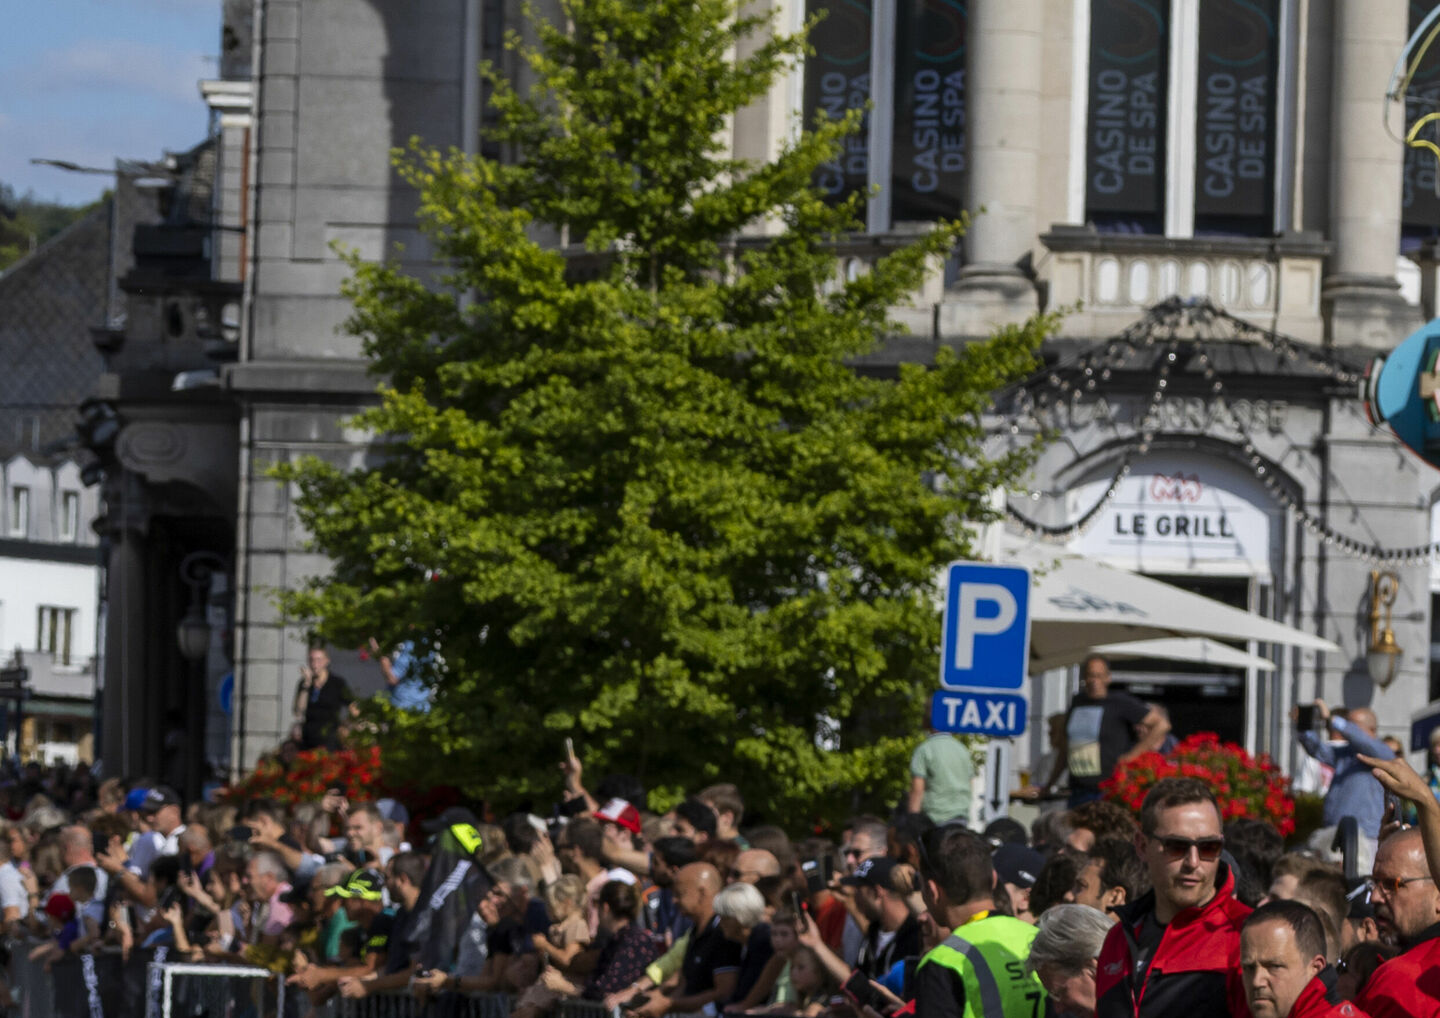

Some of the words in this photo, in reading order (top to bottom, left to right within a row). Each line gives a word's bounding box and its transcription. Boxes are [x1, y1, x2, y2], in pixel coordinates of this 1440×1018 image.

[942, 70, 966, 127] SPA
[1129, 71, 1159, 129] SPA
[1240, 75, 1268, 132] SPA
[912, 69, 941, 193] CASINO
[941, 133, 965, 172] DE
[1093, 69, 1127, 194] CASINO
[1127, 136, 1156, 175] DE
[1204, 73, 1237, 197] CASINO
[1237, 138, 1266, 179] DE
[1115, 512, 1147, 536] LE
[1155, 514, 1235, 538] GRILL
[954, 581, 1018, 671] P
[942, 697, 1017, 731] TAXI
